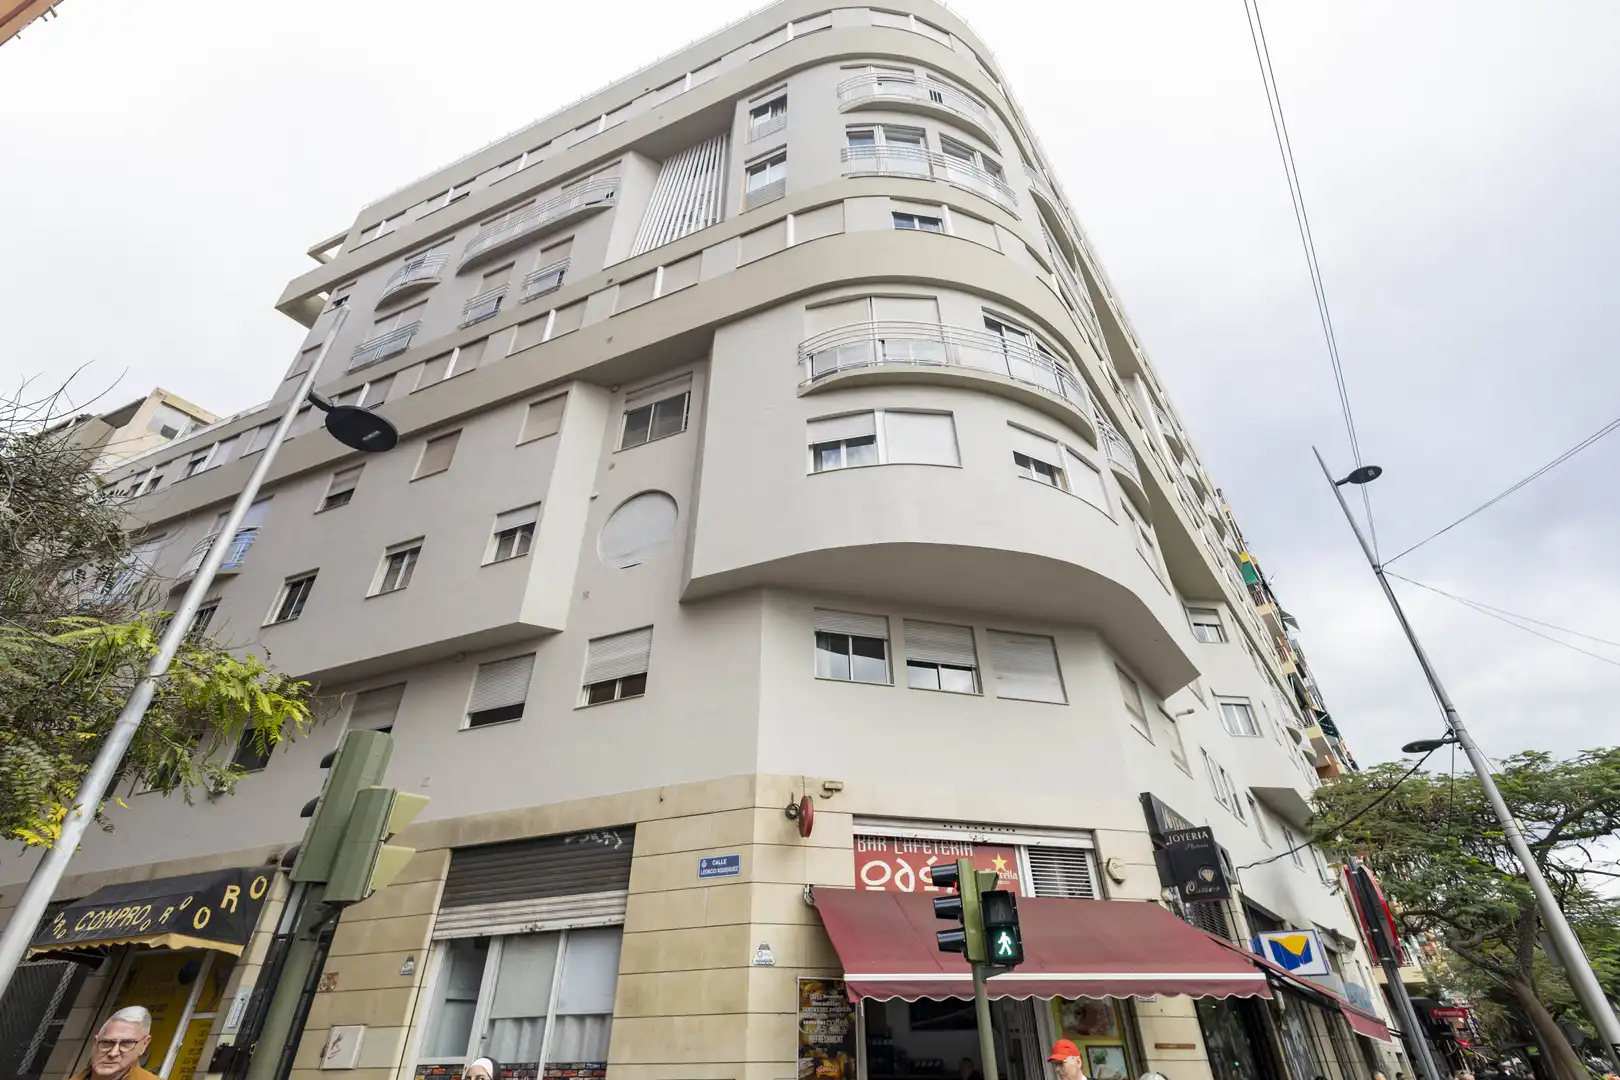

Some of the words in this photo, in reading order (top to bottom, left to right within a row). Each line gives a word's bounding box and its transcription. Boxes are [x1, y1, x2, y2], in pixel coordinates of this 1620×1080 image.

[857, 836, 887, 852] BAR
[893, 837, 974, 857] CAFETERIA
[711, 858, 727, 866] CALLE
[193, 875, 268, 930] ORO
[74, 904, 152, 932] COMPRO
[139, 895, 194, 932] ORO
[826, 1018, 849, 1027] coffee
[808, 1034, 844, 1044] REFRESHMENT
